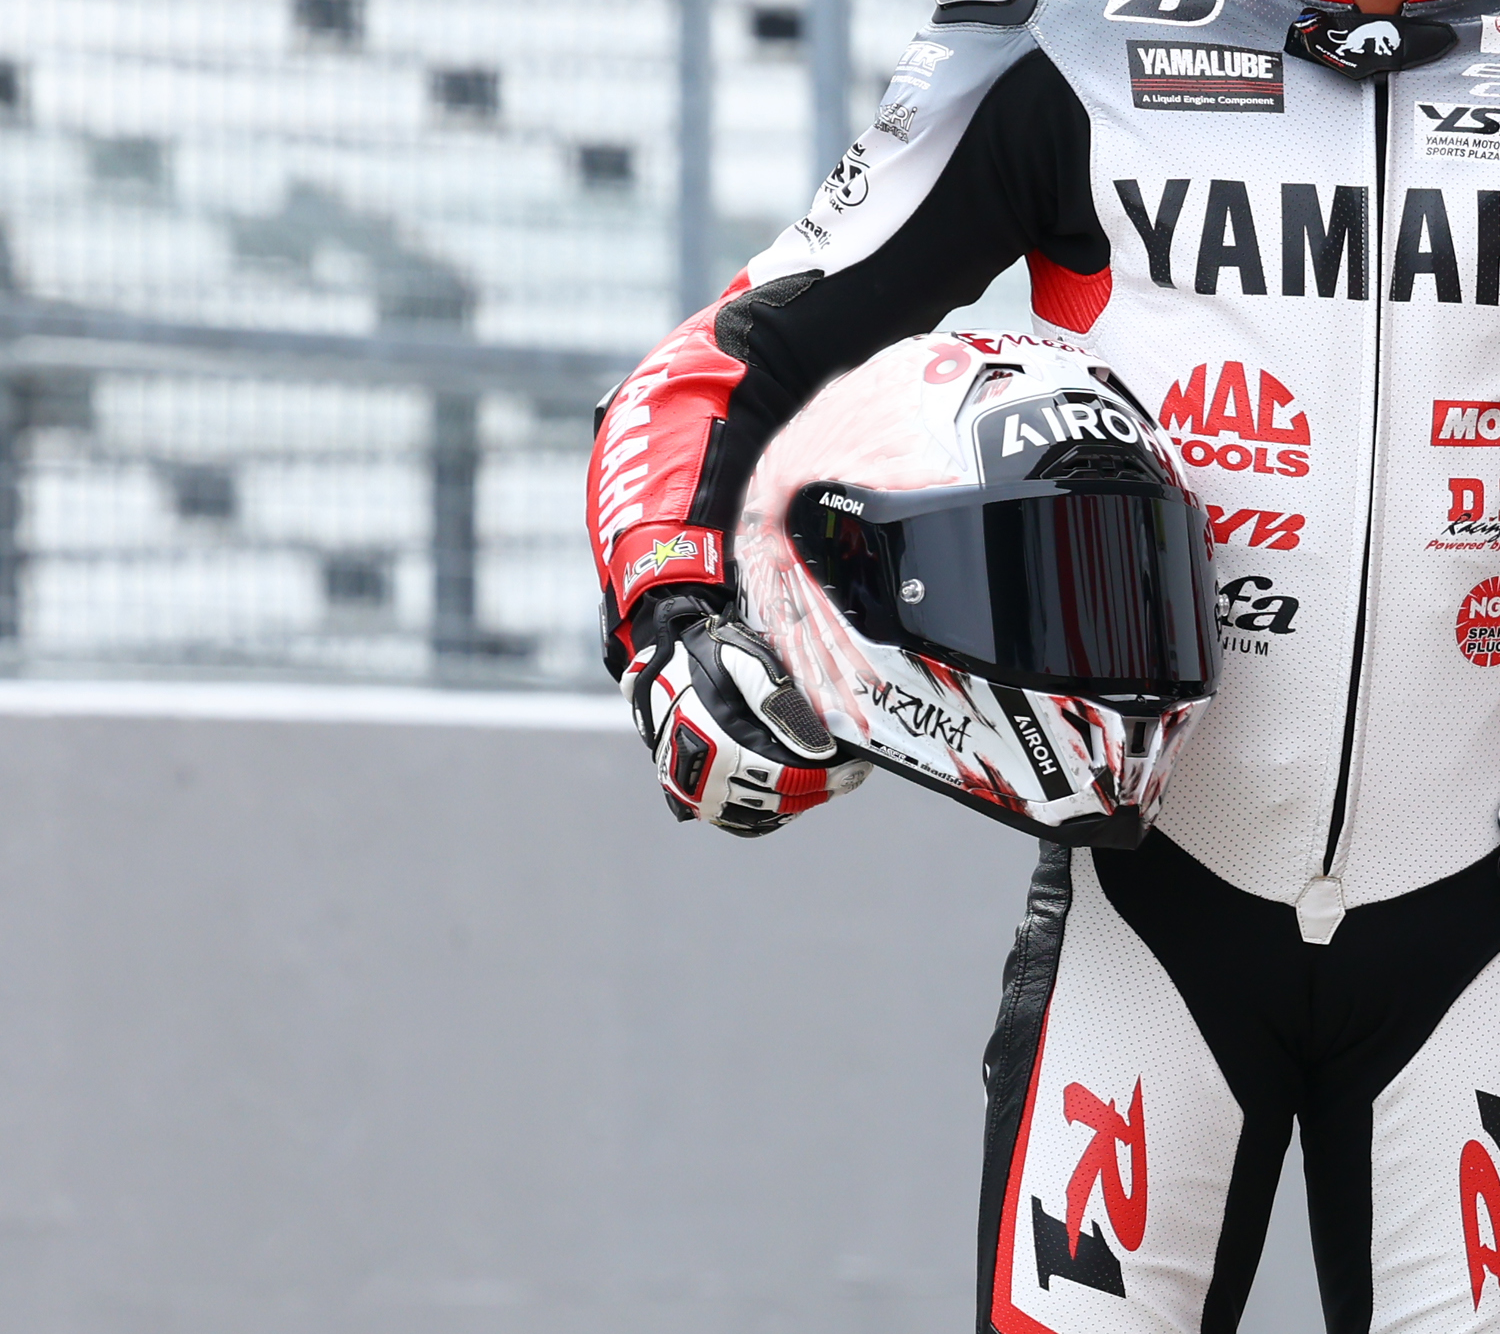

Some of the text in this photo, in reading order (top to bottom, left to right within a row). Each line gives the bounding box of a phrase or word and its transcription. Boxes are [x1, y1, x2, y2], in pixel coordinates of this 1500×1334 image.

[1137, 47, 1274, 79] YAMALUBE
[1142, 94, 1275, 106] A Liquid Engine Component
[1425, 135, 1470, 148] YAMAHA
[1425, 147, 1500, 162] SPORTS PLAZA
[1159, 360, 1312, 446] MAC
[818, 491, 865, 517] AIROH
[1424, 539, 1487, 551] Powered
[854, 669, 974, 754] SUZUKA
[1013, 714, 1058, 776] AIROH
[1031, 1073, 1148, 1300] R1
